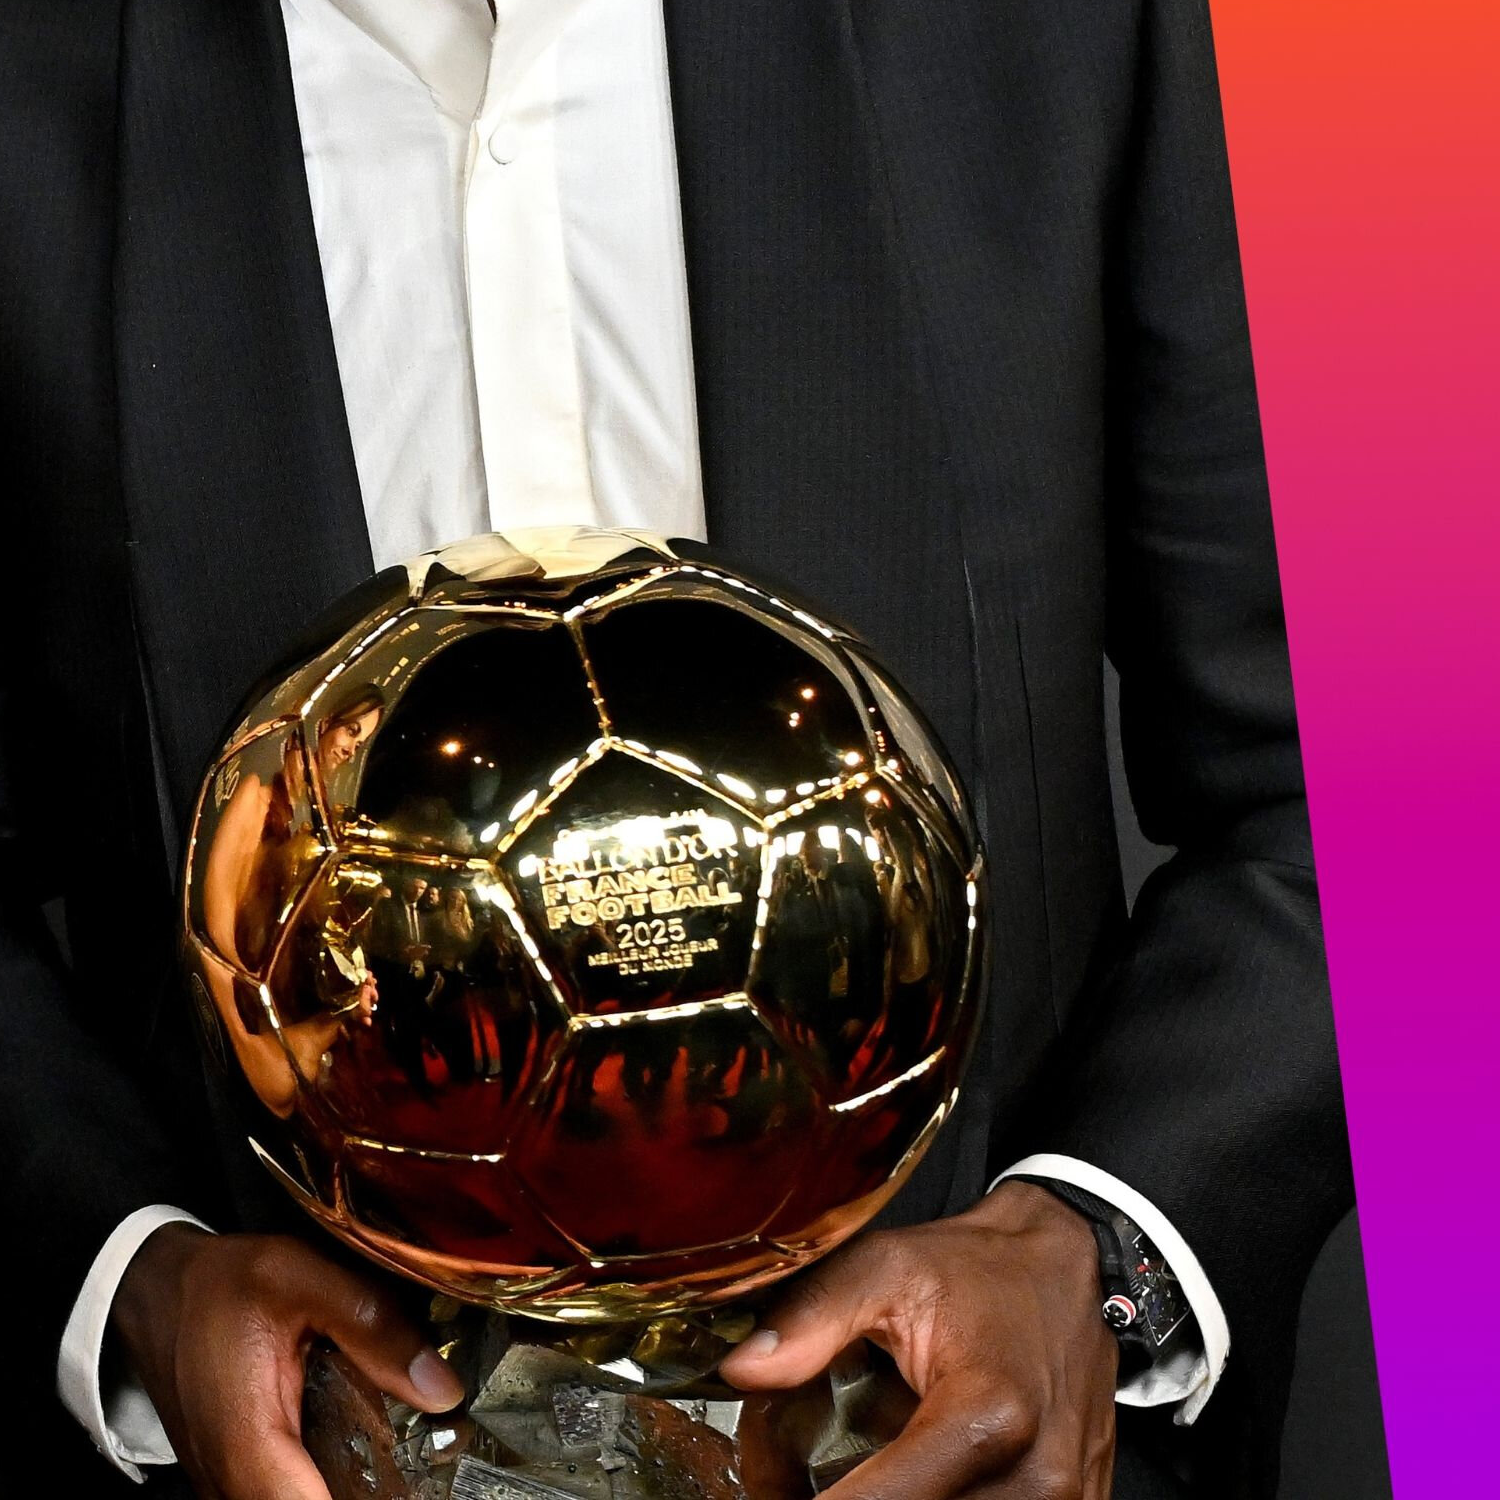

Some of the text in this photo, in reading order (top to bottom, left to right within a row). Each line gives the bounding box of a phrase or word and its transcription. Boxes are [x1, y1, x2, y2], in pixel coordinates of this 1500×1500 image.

[541, 863, 697, 907] FRANCE
[546, 881, 742, 930] FOOTBALL
[616, 917, 687, 949] 2025
